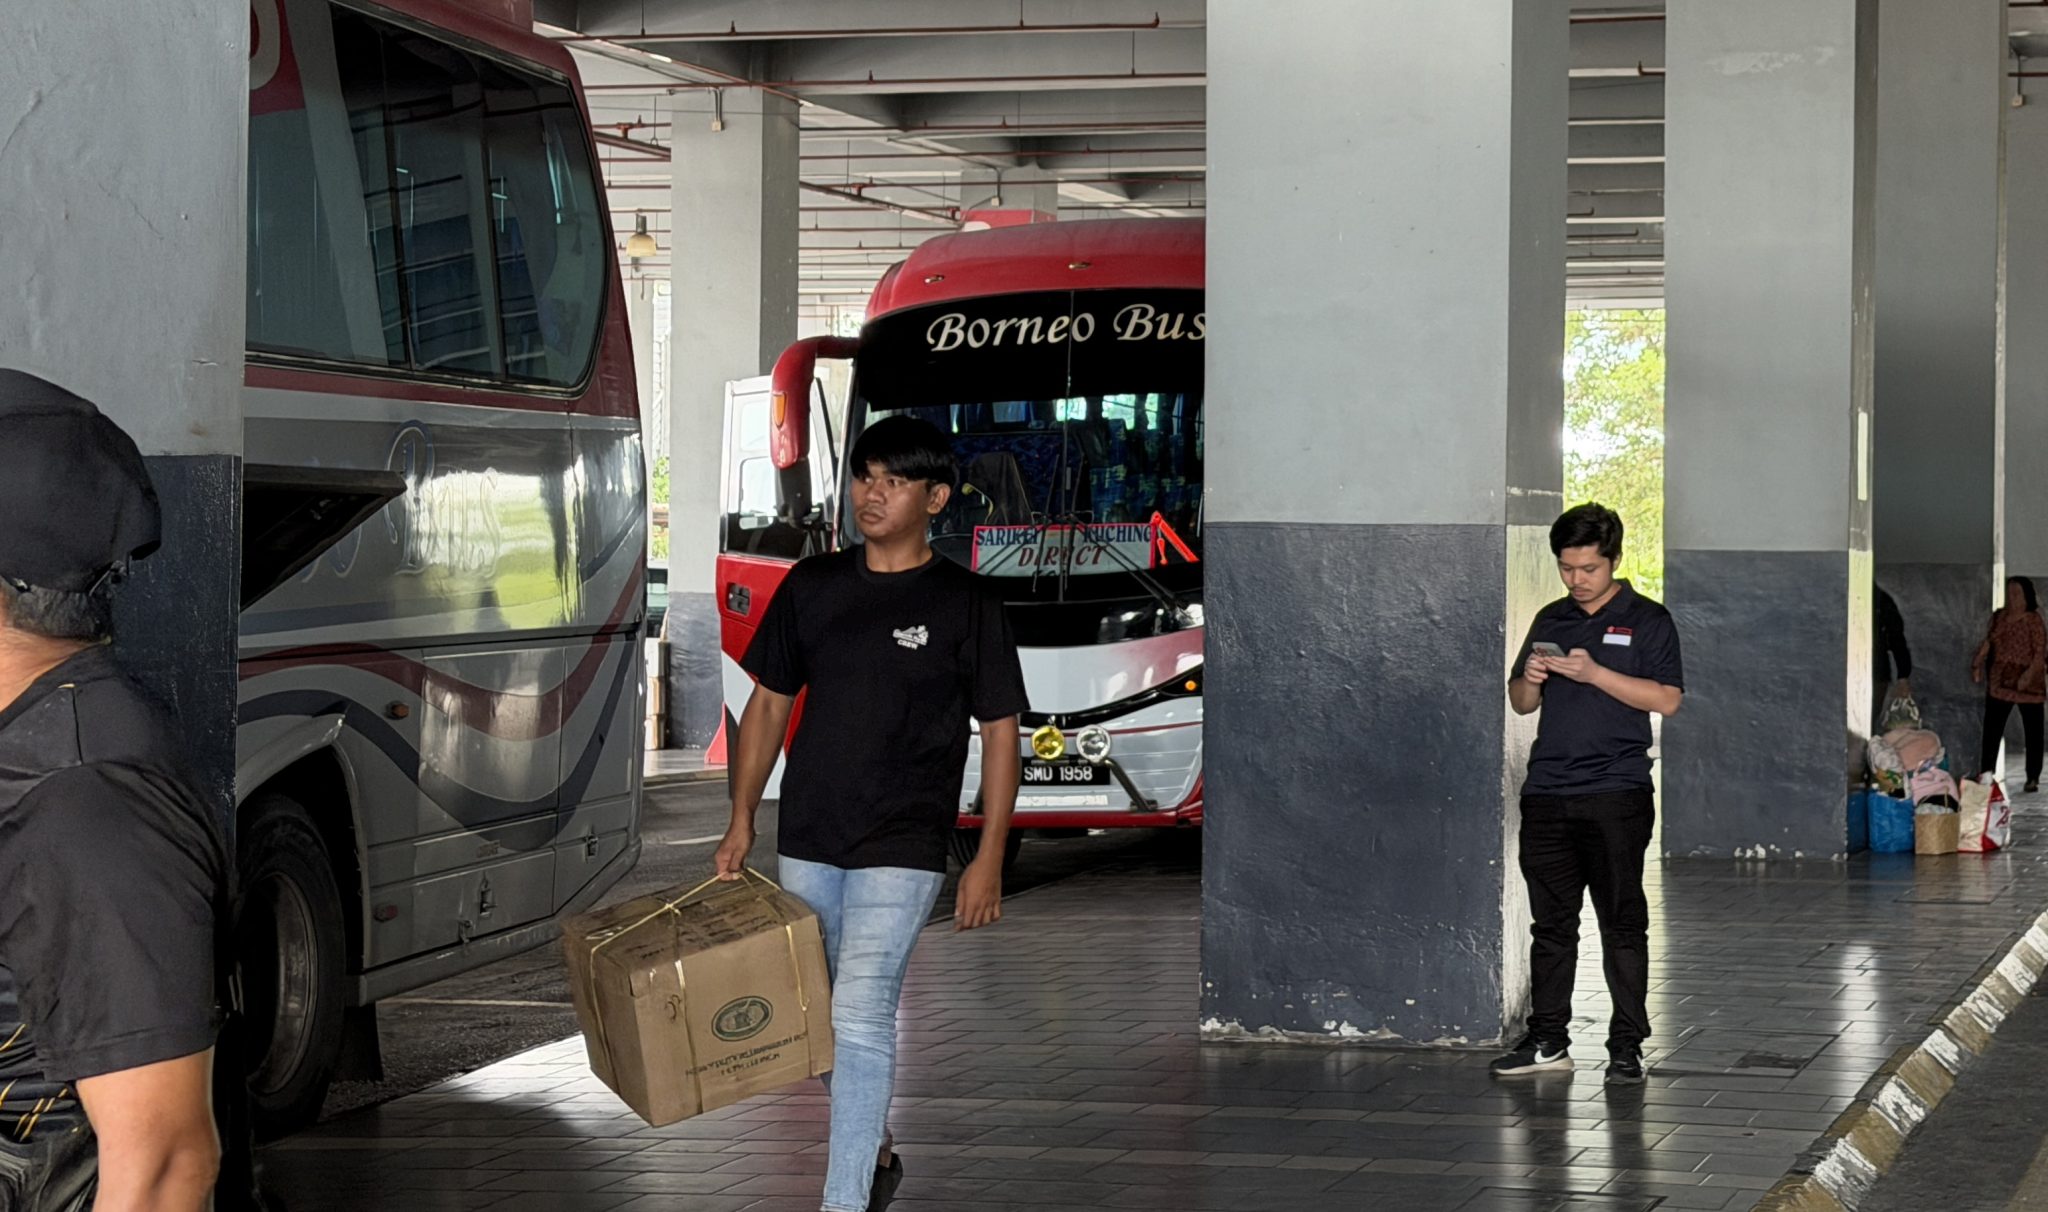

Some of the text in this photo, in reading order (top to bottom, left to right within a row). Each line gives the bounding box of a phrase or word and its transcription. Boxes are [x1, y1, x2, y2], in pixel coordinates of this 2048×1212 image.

[926, 303, 1205, 352] Borneo Bus
[1023, 766, 1093, 782] SMD 1958
